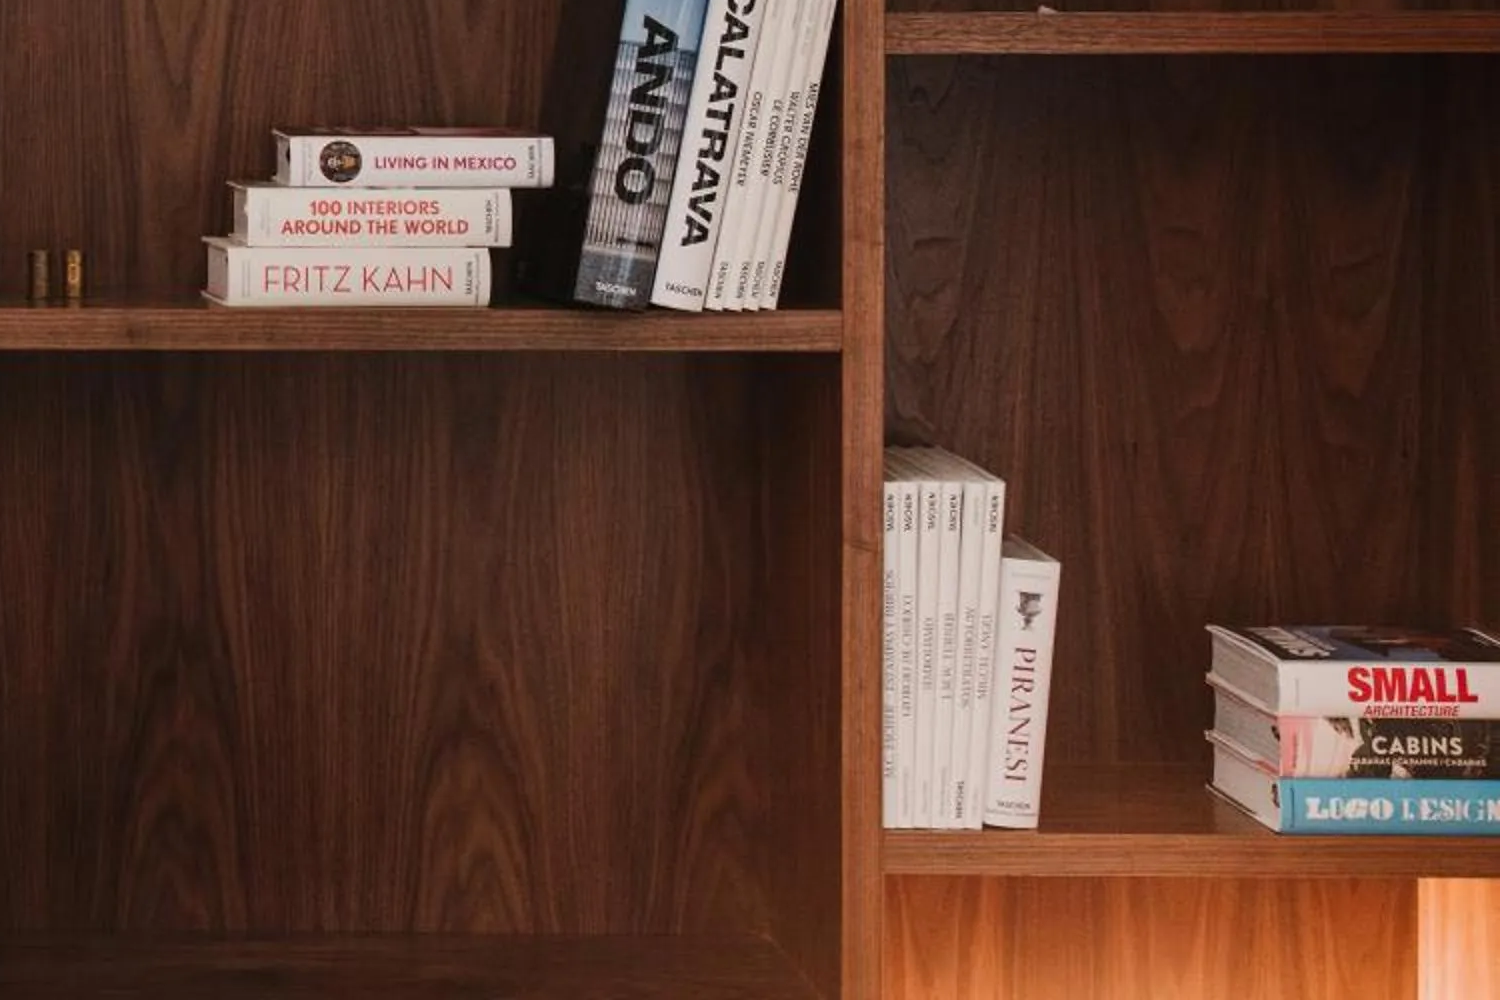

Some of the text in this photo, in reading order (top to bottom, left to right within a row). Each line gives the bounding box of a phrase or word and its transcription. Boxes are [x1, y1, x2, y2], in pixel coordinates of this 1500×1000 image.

[614, 14, 680, 206] ANDO
[748, 91, 763, 129] OSCAR
[783, 91, 800, 133] WALTER
[760, 112, 781, 177] CORBUSIER
[374, 156, 517, 170] LIVING IN MEXICO
[309, 200, 440, 215] 100 INTERIORS
[281, 220, 470, 236] AROUND THE WORLD
[264, 265, 453, 294] FRITZ KAHN
[595, 281, 637, 296] TASCHEN
[665, 281, 703, 298] TASCHEN
[1347, 667, 1479, 703] SMALL
[1005, 647, 1037, 782] PIRANESI
[1363, 704, 1460, 718] ARCHITECTURE
[1371, 735, 1464, 756] CABINS
[997, 799, 1031, 810] TASCHEN
[1305, 796, 1394, 821] LOGO
